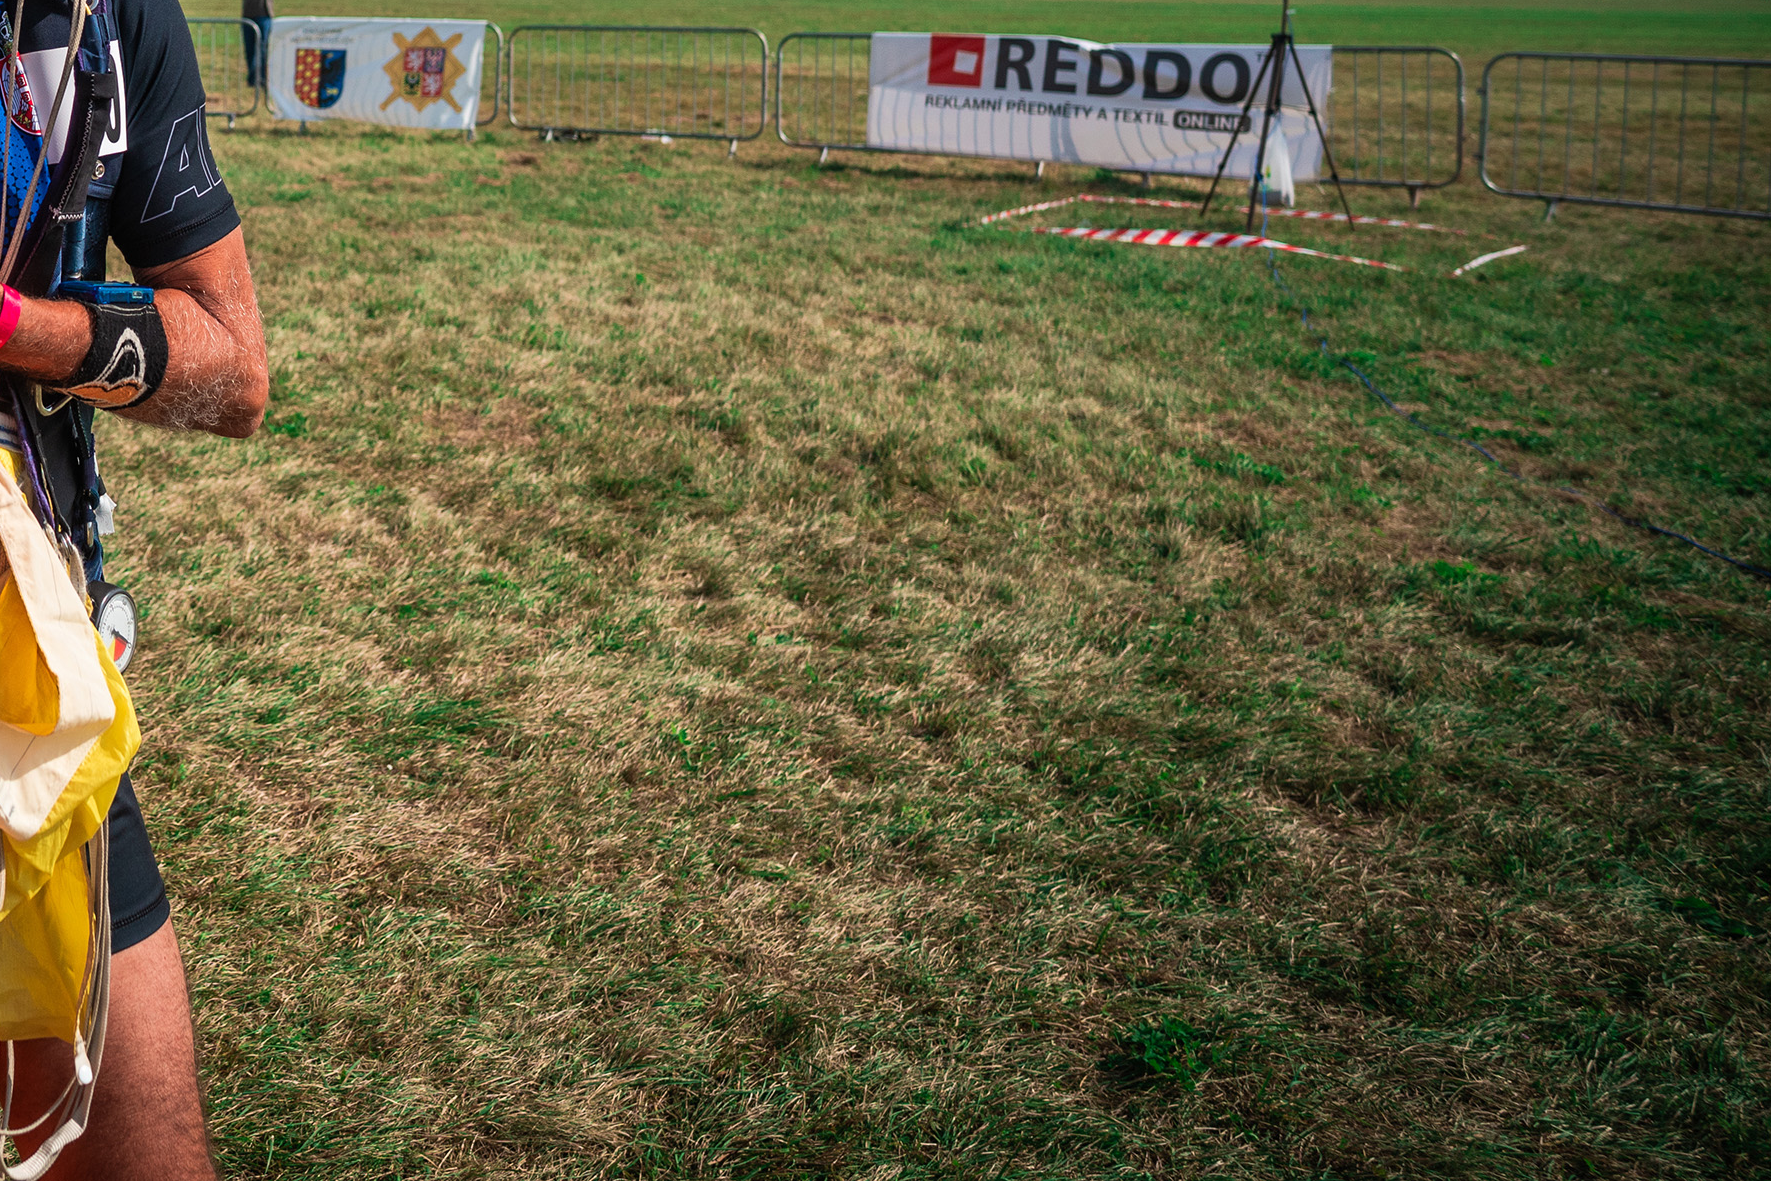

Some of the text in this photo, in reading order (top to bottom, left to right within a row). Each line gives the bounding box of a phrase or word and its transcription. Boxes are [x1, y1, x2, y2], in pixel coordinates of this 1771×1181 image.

[994, 37, 1251, 104] REDDO
[924, 94, 1003, 112] REKLAMNÍ
[1006, 99, 1093, 119] PŘEDMĚTY
[1097, 107, 1107, 121] A
[1113, 107, 1169, 126] TEXTIL
